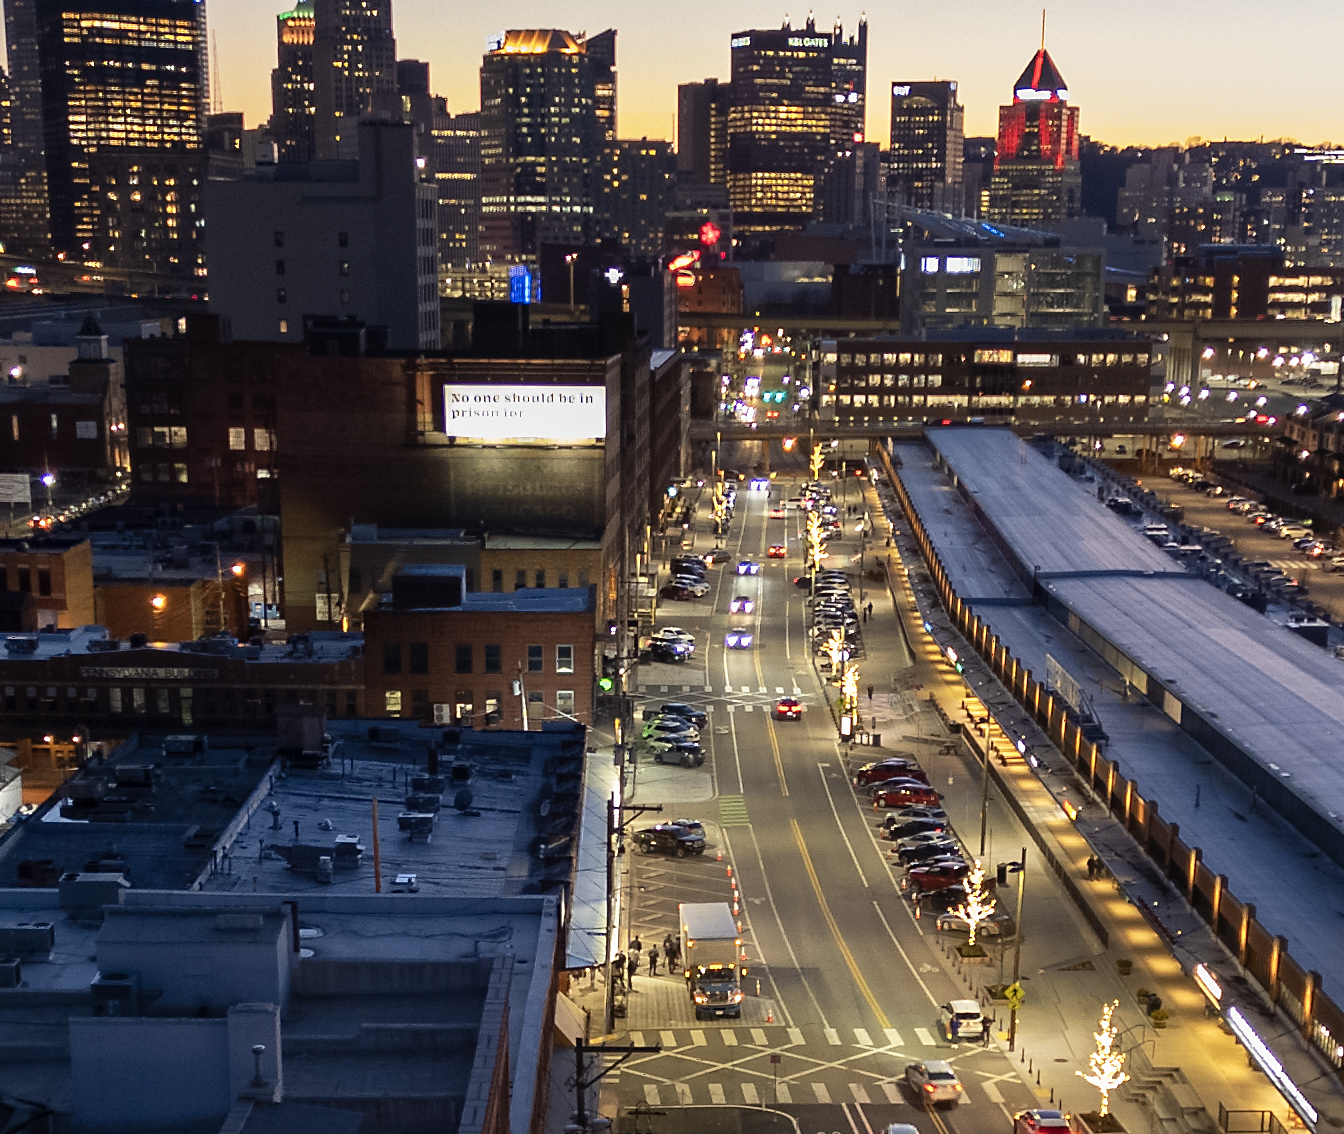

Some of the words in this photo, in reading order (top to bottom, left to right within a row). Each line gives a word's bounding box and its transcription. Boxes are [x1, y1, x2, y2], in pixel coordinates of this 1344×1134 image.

[451, 392, 469, 403] No
[474, 394, 500, 403] one
[503, 392, 554, 403] should
[559, 392, 576, 403] be
[579, 393, 594, 404] in
[451, 407, 499, 419] prison
[80, 667, 159, 678] PENNSYLVANIA
